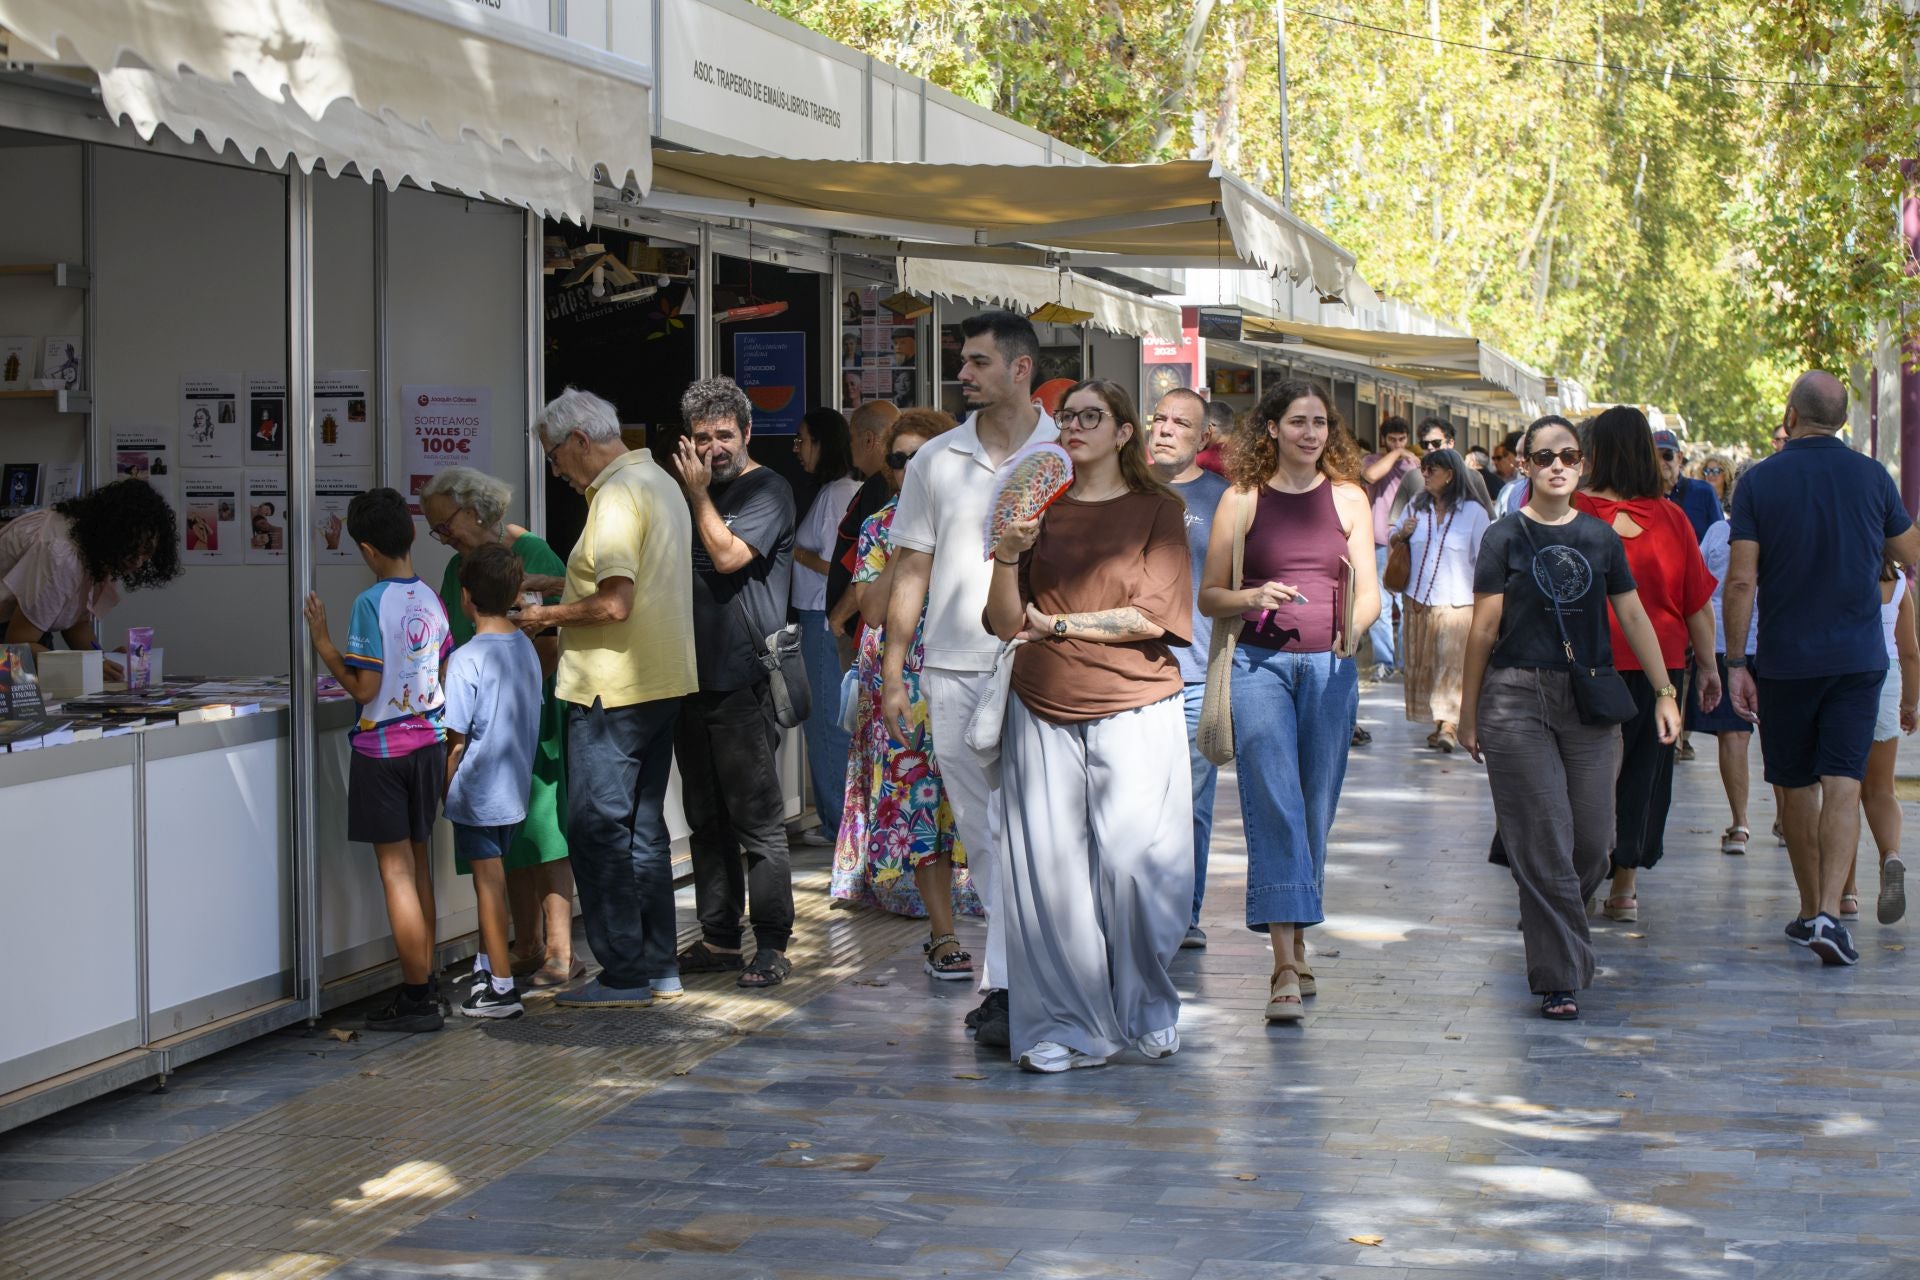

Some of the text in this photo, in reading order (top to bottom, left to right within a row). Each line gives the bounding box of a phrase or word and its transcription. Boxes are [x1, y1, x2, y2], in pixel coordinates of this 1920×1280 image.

[694, 60, 841, 128] ASOC. TRAPEROS DE EMAÚS-LIBROS TRAPEROS
[1153, 347, 1177, 356] 2025
[414, 416, 480, 426] SORTEAMOS
[415, 427, 479, 437] 2 VALES DE
[421, 438, 472, 454] 100€
